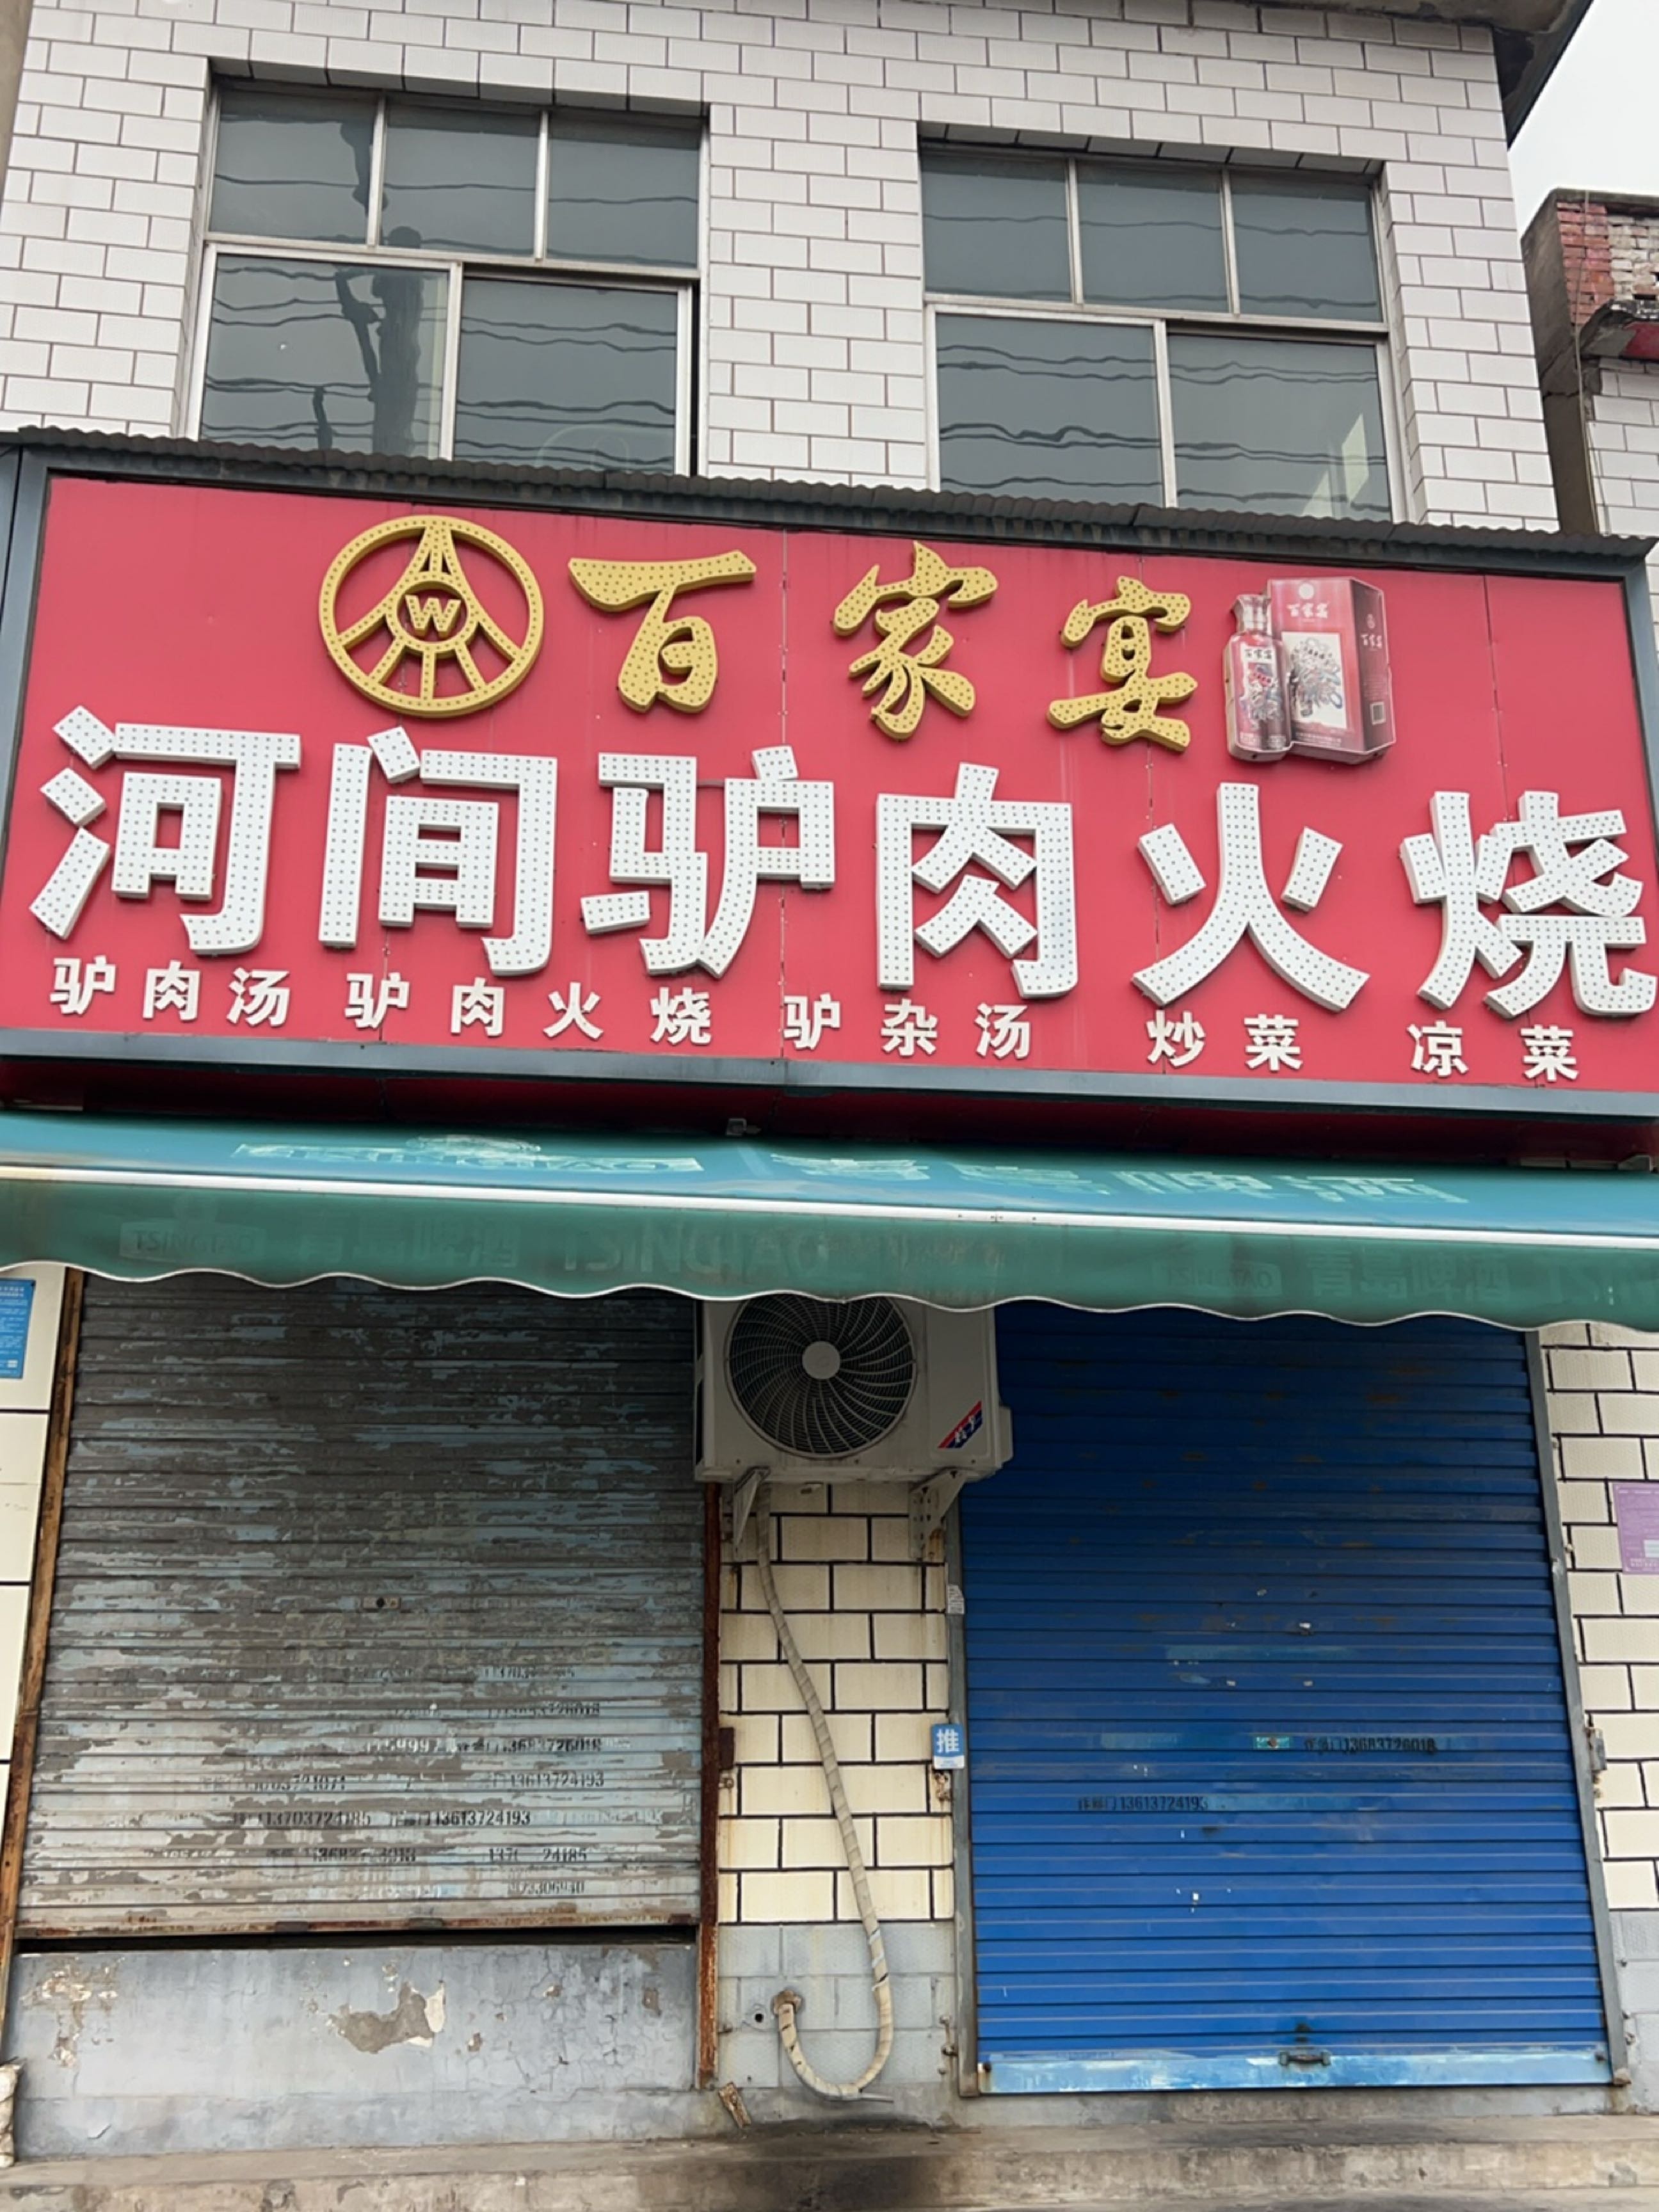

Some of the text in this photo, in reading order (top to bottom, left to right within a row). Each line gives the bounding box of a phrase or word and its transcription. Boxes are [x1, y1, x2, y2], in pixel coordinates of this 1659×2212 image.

[405, 595, 461, 637] W
[568, 540, 1199, 750] 百家宴
[29, 705, 1659, 1019] 河间驴肉火烧
[49, 955, 1579, 1082] 驴肉汤 驴肉火烧 驴杂汤 炒菜 凉菜
[936, 1729, 959, 1753] 推
